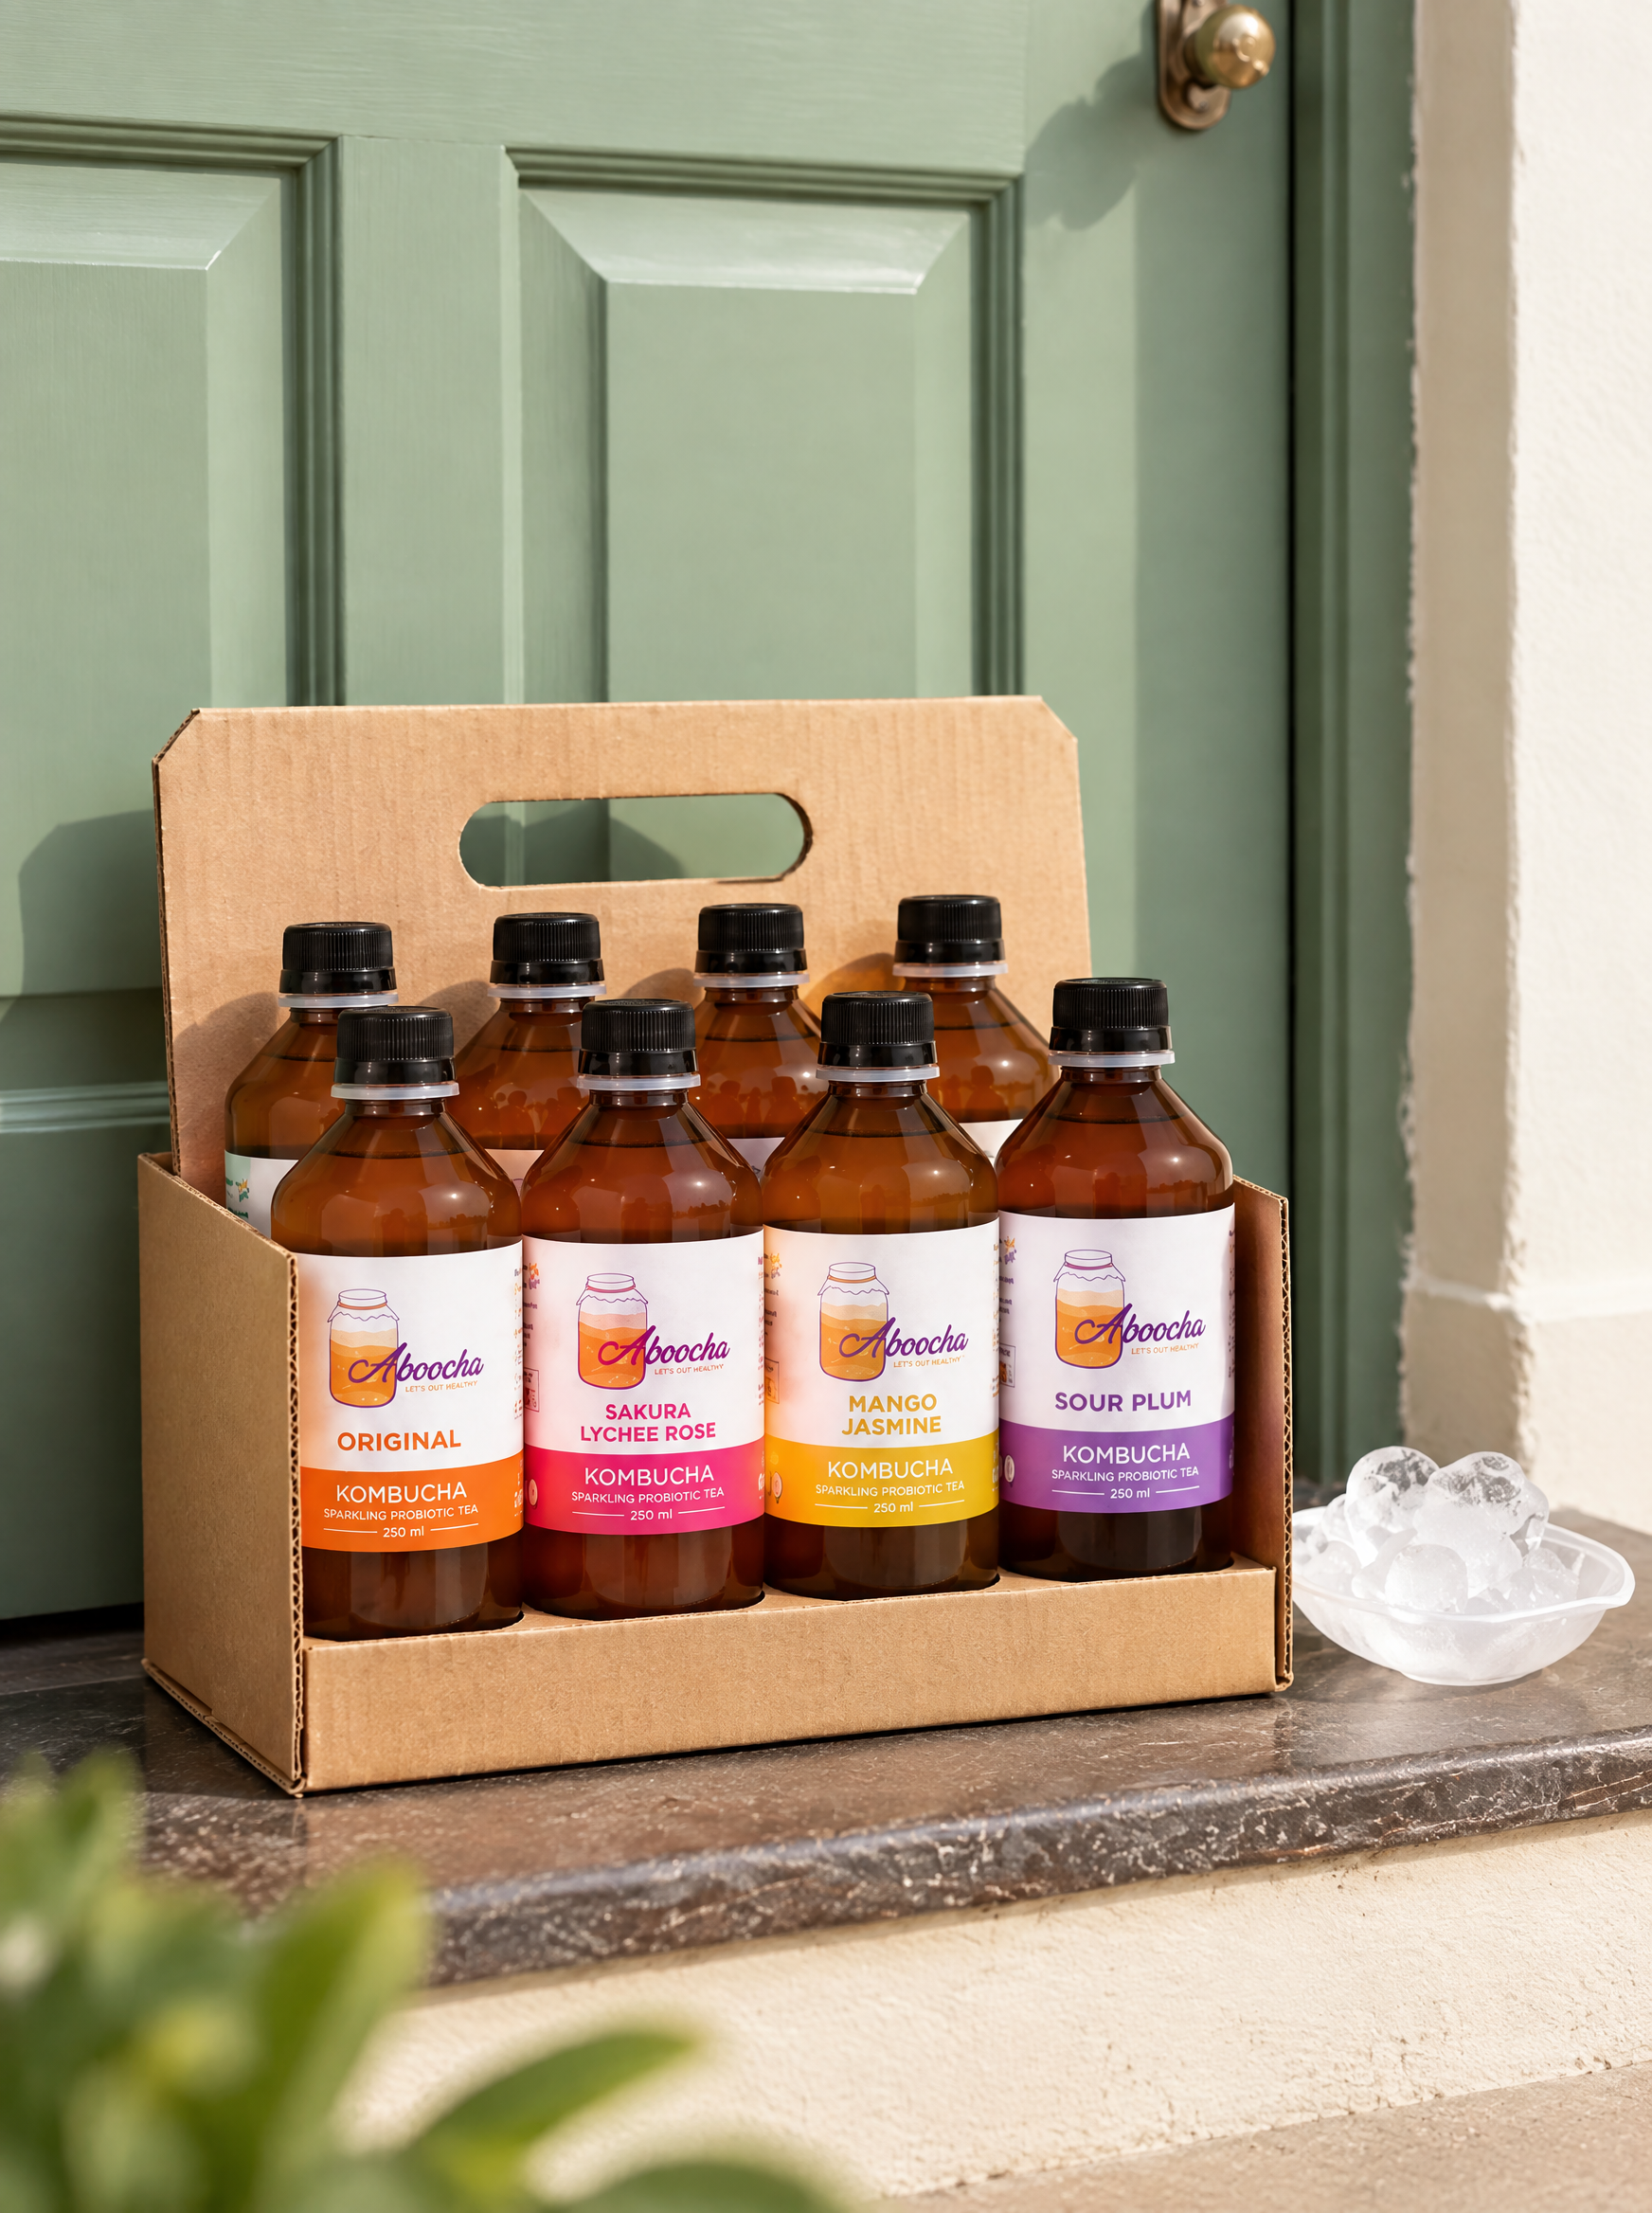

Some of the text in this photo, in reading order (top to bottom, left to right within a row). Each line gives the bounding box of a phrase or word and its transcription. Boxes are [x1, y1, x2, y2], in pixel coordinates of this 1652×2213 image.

[1074, 1303, 1206, 1344] Aboocha
[598, 1325, 730, 1366] Aboocha
[839, 1316, 969, 1358] Aboocha
[348, 1341, 484, 1384] Aboocha
[849, 1394, 937, 1412] MANGO
[1054, 1390, 1192, 1412] SOUR PLUM
[605, 1403, 691, 1420] SAKURA
[581, 1422, 716, 1443] LYCHEE ROSE
[841, 1415, 942, 1435] JASMINE
[337, 1429, 461, 1451] ORIGINAL
[1063, 1442, 1190, 1464] KOMBUCHA
[584, 1465, 714, 1486] KOMBUCHA
[828, 1458, 953, 1480] KOMBUCHA
[1051, 1466, 1199, 1482] SPARKLING PROBIOTIC TEA
[336, 1481, 467, 1504] KOMBUCHA
[571, 1487, 725, 1504] SPARKLING PROBIOTIC TEA
[816, 1482, 964, 1497] SPARKLING PROBIOTIC TEA
[1110, 1486, 1150, 1499] 250 ml
[324, 1504, 478, 1521] SPARKLING PROBIOTIC TEA
[630, 1508, 673, 1521] 250 ml
[873, 1502, 913, 1513] 250 ml
[383, 1525, 424, 1538] 250 ml
